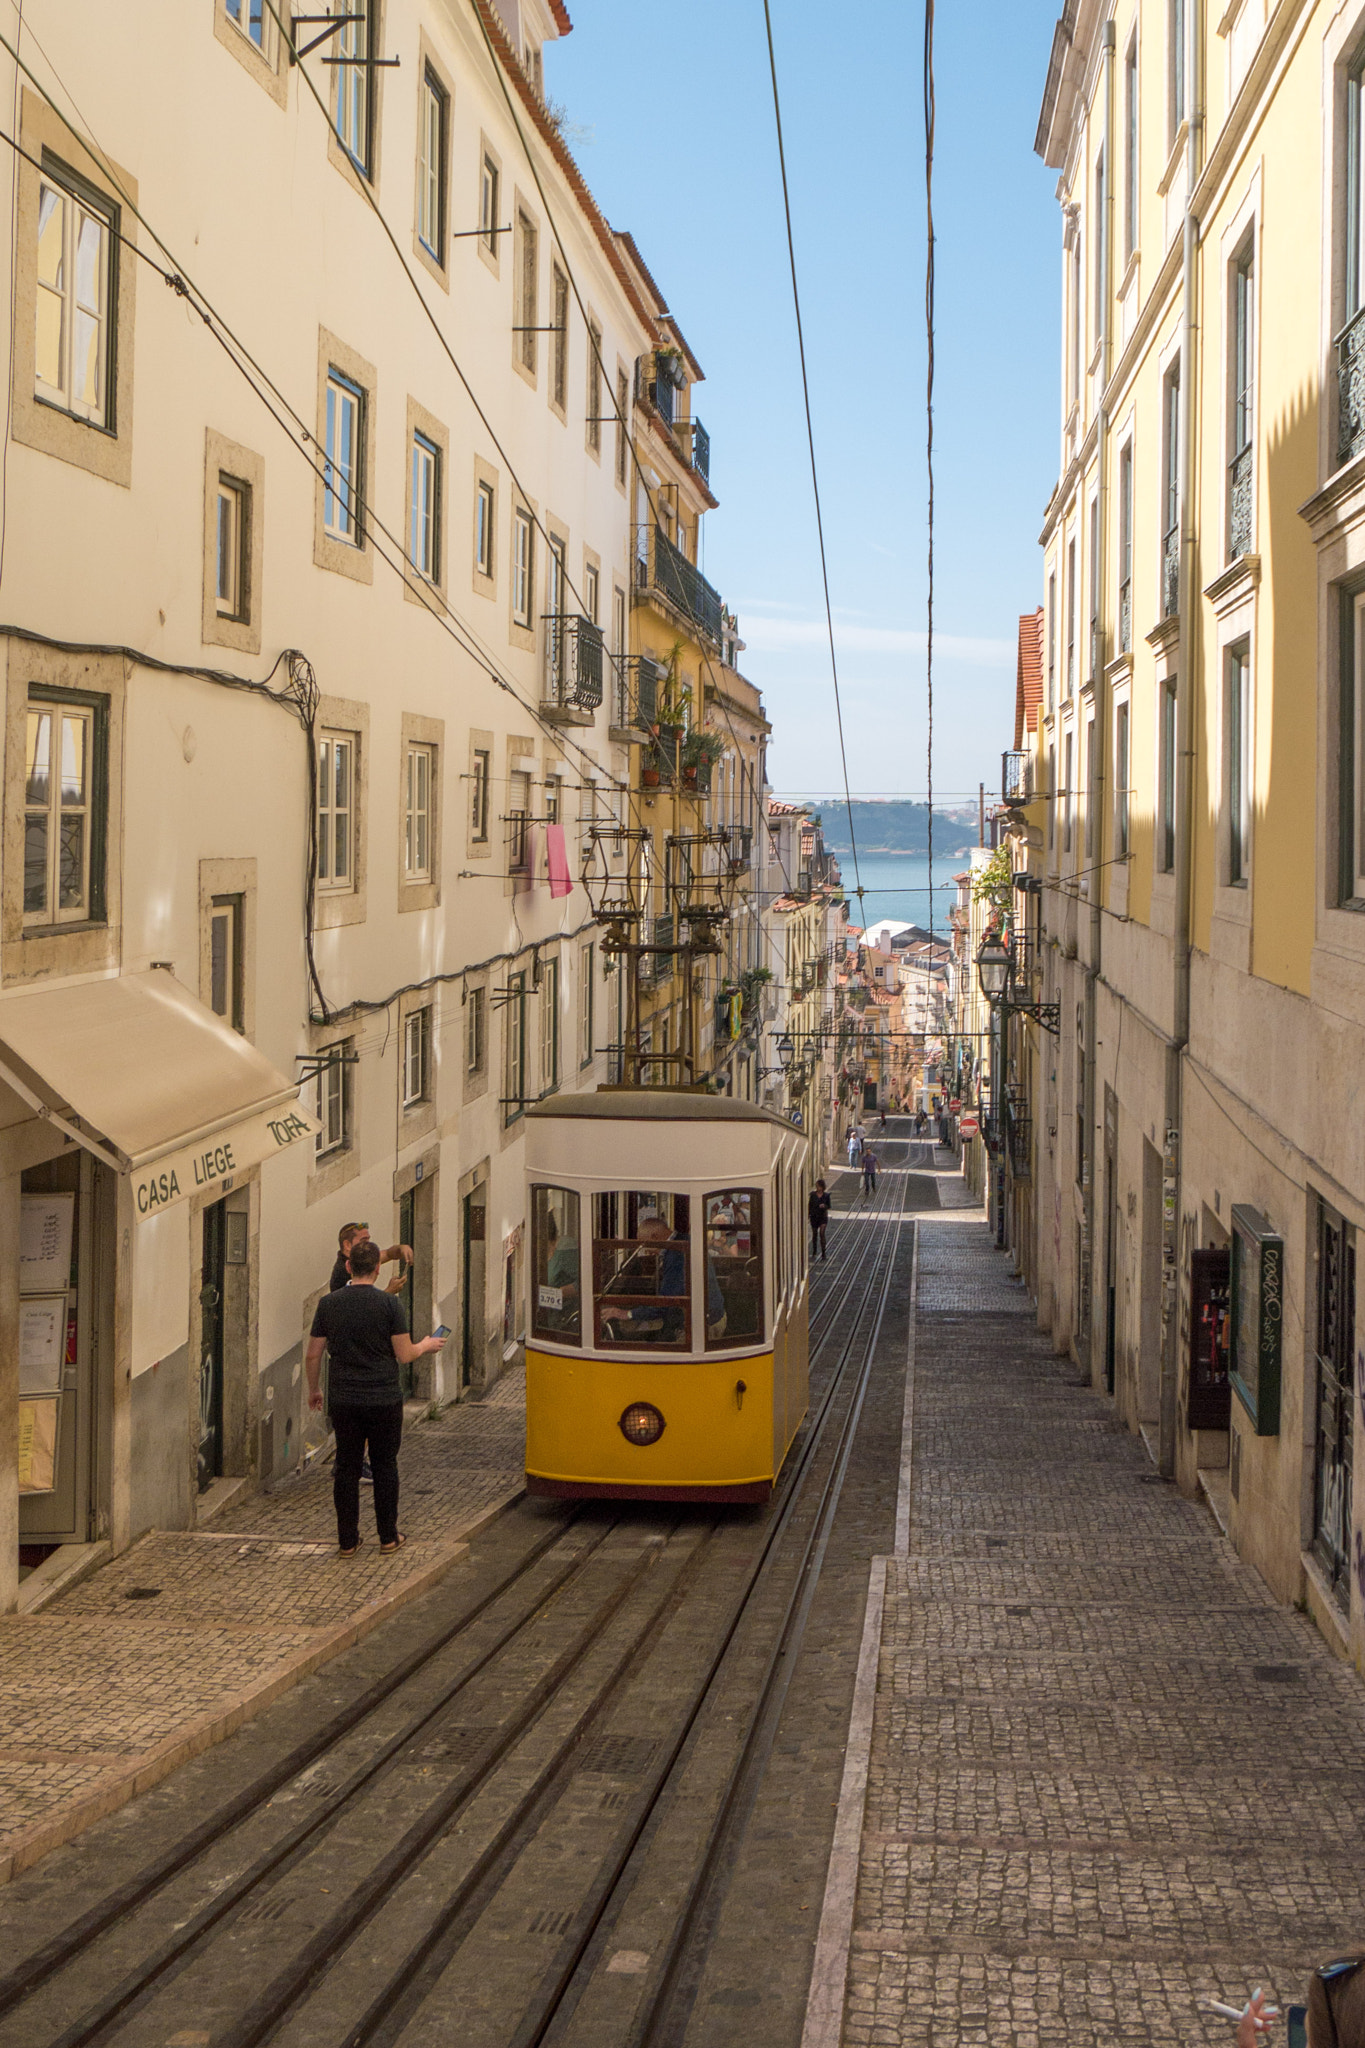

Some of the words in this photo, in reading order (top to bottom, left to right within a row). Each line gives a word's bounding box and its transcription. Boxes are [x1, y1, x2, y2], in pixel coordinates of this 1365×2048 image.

[266, 1112, 311, 1146] TOFA
[137, 1169, 181, 1214] CASA
[193, 1143, 236, 1185] LIEGE
